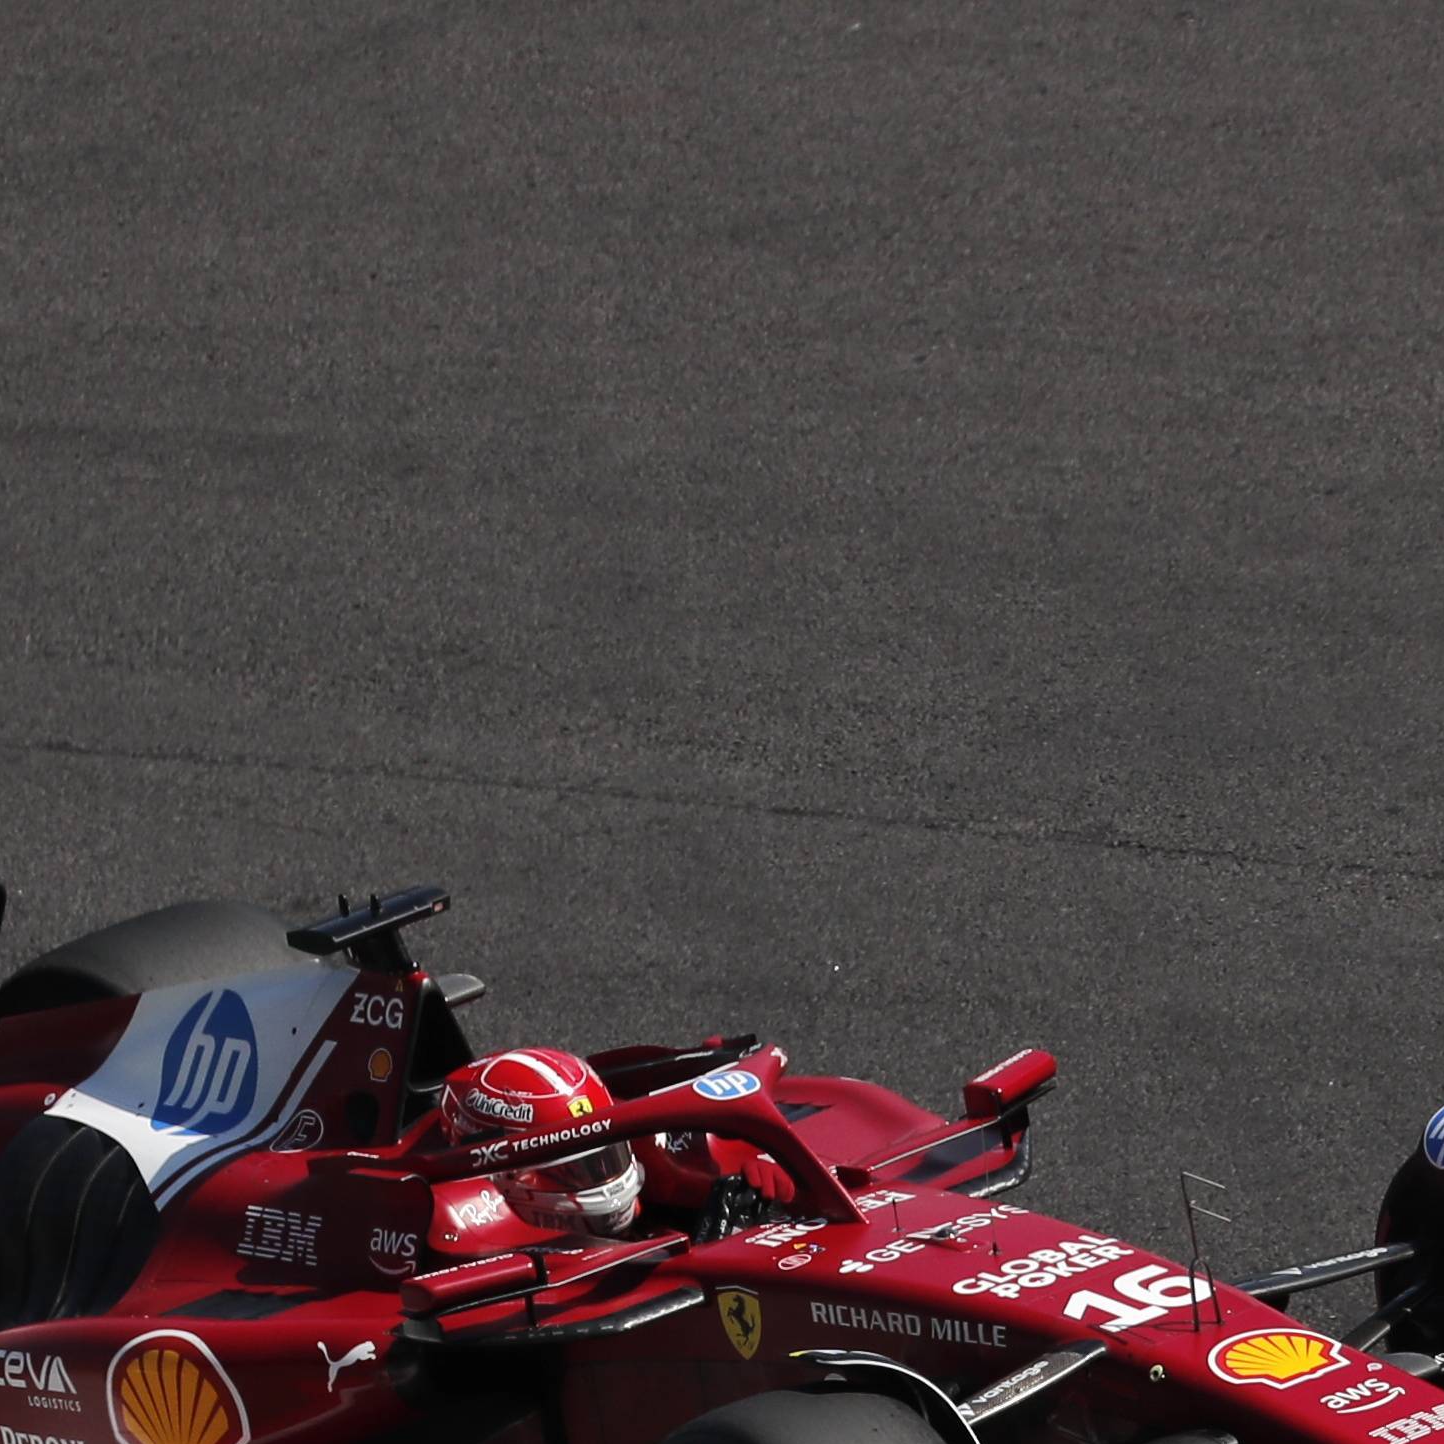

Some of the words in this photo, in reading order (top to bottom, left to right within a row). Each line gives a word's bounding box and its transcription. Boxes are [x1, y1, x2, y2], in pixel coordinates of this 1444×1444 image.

[349, 992, 405, 1030] ZCG
[163, 990, 253, 1130] hp
[699, 1070, 751, 1097] hp
[474, 1094, 533, 1123] UniCredit
[470, 1140, 509, 1167] DXC
[512, 1119, 612, 1152] TECHNOLOGY
[237, 1204, 323, 1267] IBM
[369, 1227, 419, 1258] aws
[952, 1234, 1118, 1295] GLOBAL
[989, 1244, 1135, 1299] POKER
[1062, 1263, 1213, 1333] 16
[810, 1301, 922, 1337] RICHARD
[930, 1317, 1007, 1348] MILLE
[28, 1395, 82, 1413] LOGISTICS
[971, 1360, 1050, 1404] vantage
[1319, 1377, 1391, 1410] aws
